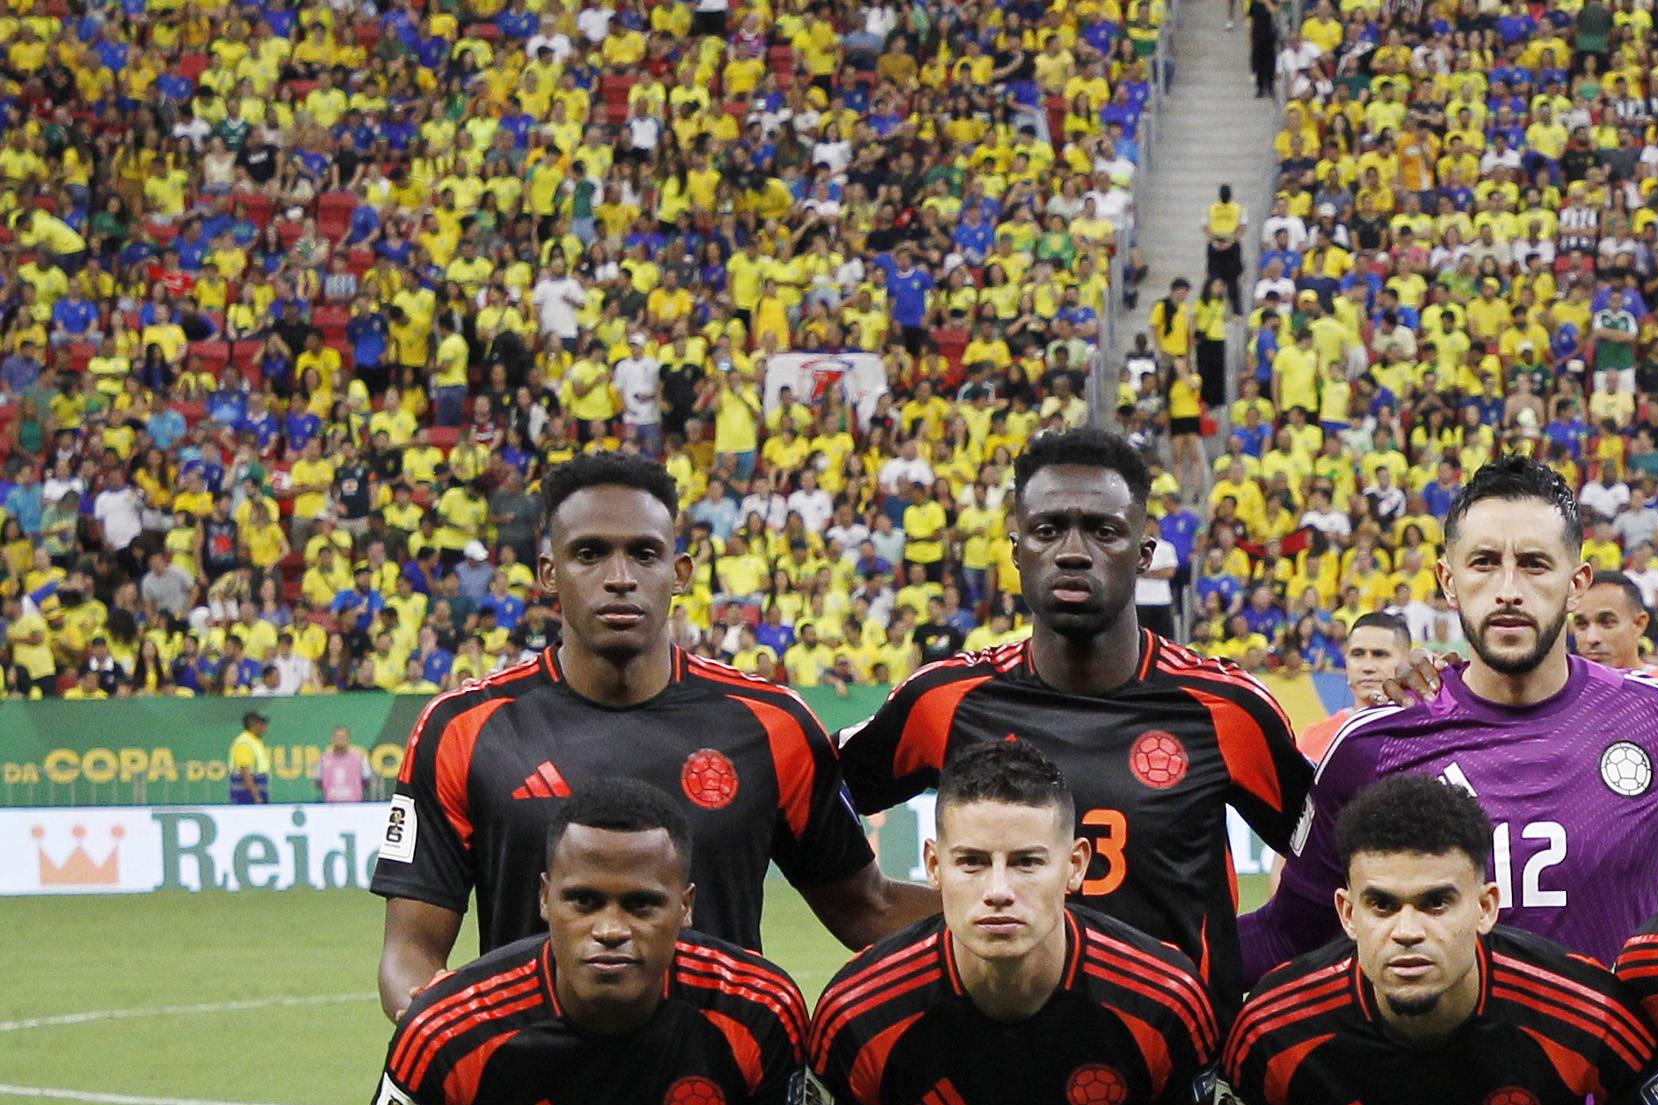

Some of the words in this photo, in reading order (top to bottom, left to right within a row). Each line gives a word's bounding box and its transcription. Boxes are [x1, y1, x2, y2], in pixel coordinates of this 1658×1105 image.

[4, 762, 40, 784] DA
[44, 747, 179, 784] COPA
[186, 759, 227, 782] DO
[1492, 821, 1567, 908] 12
